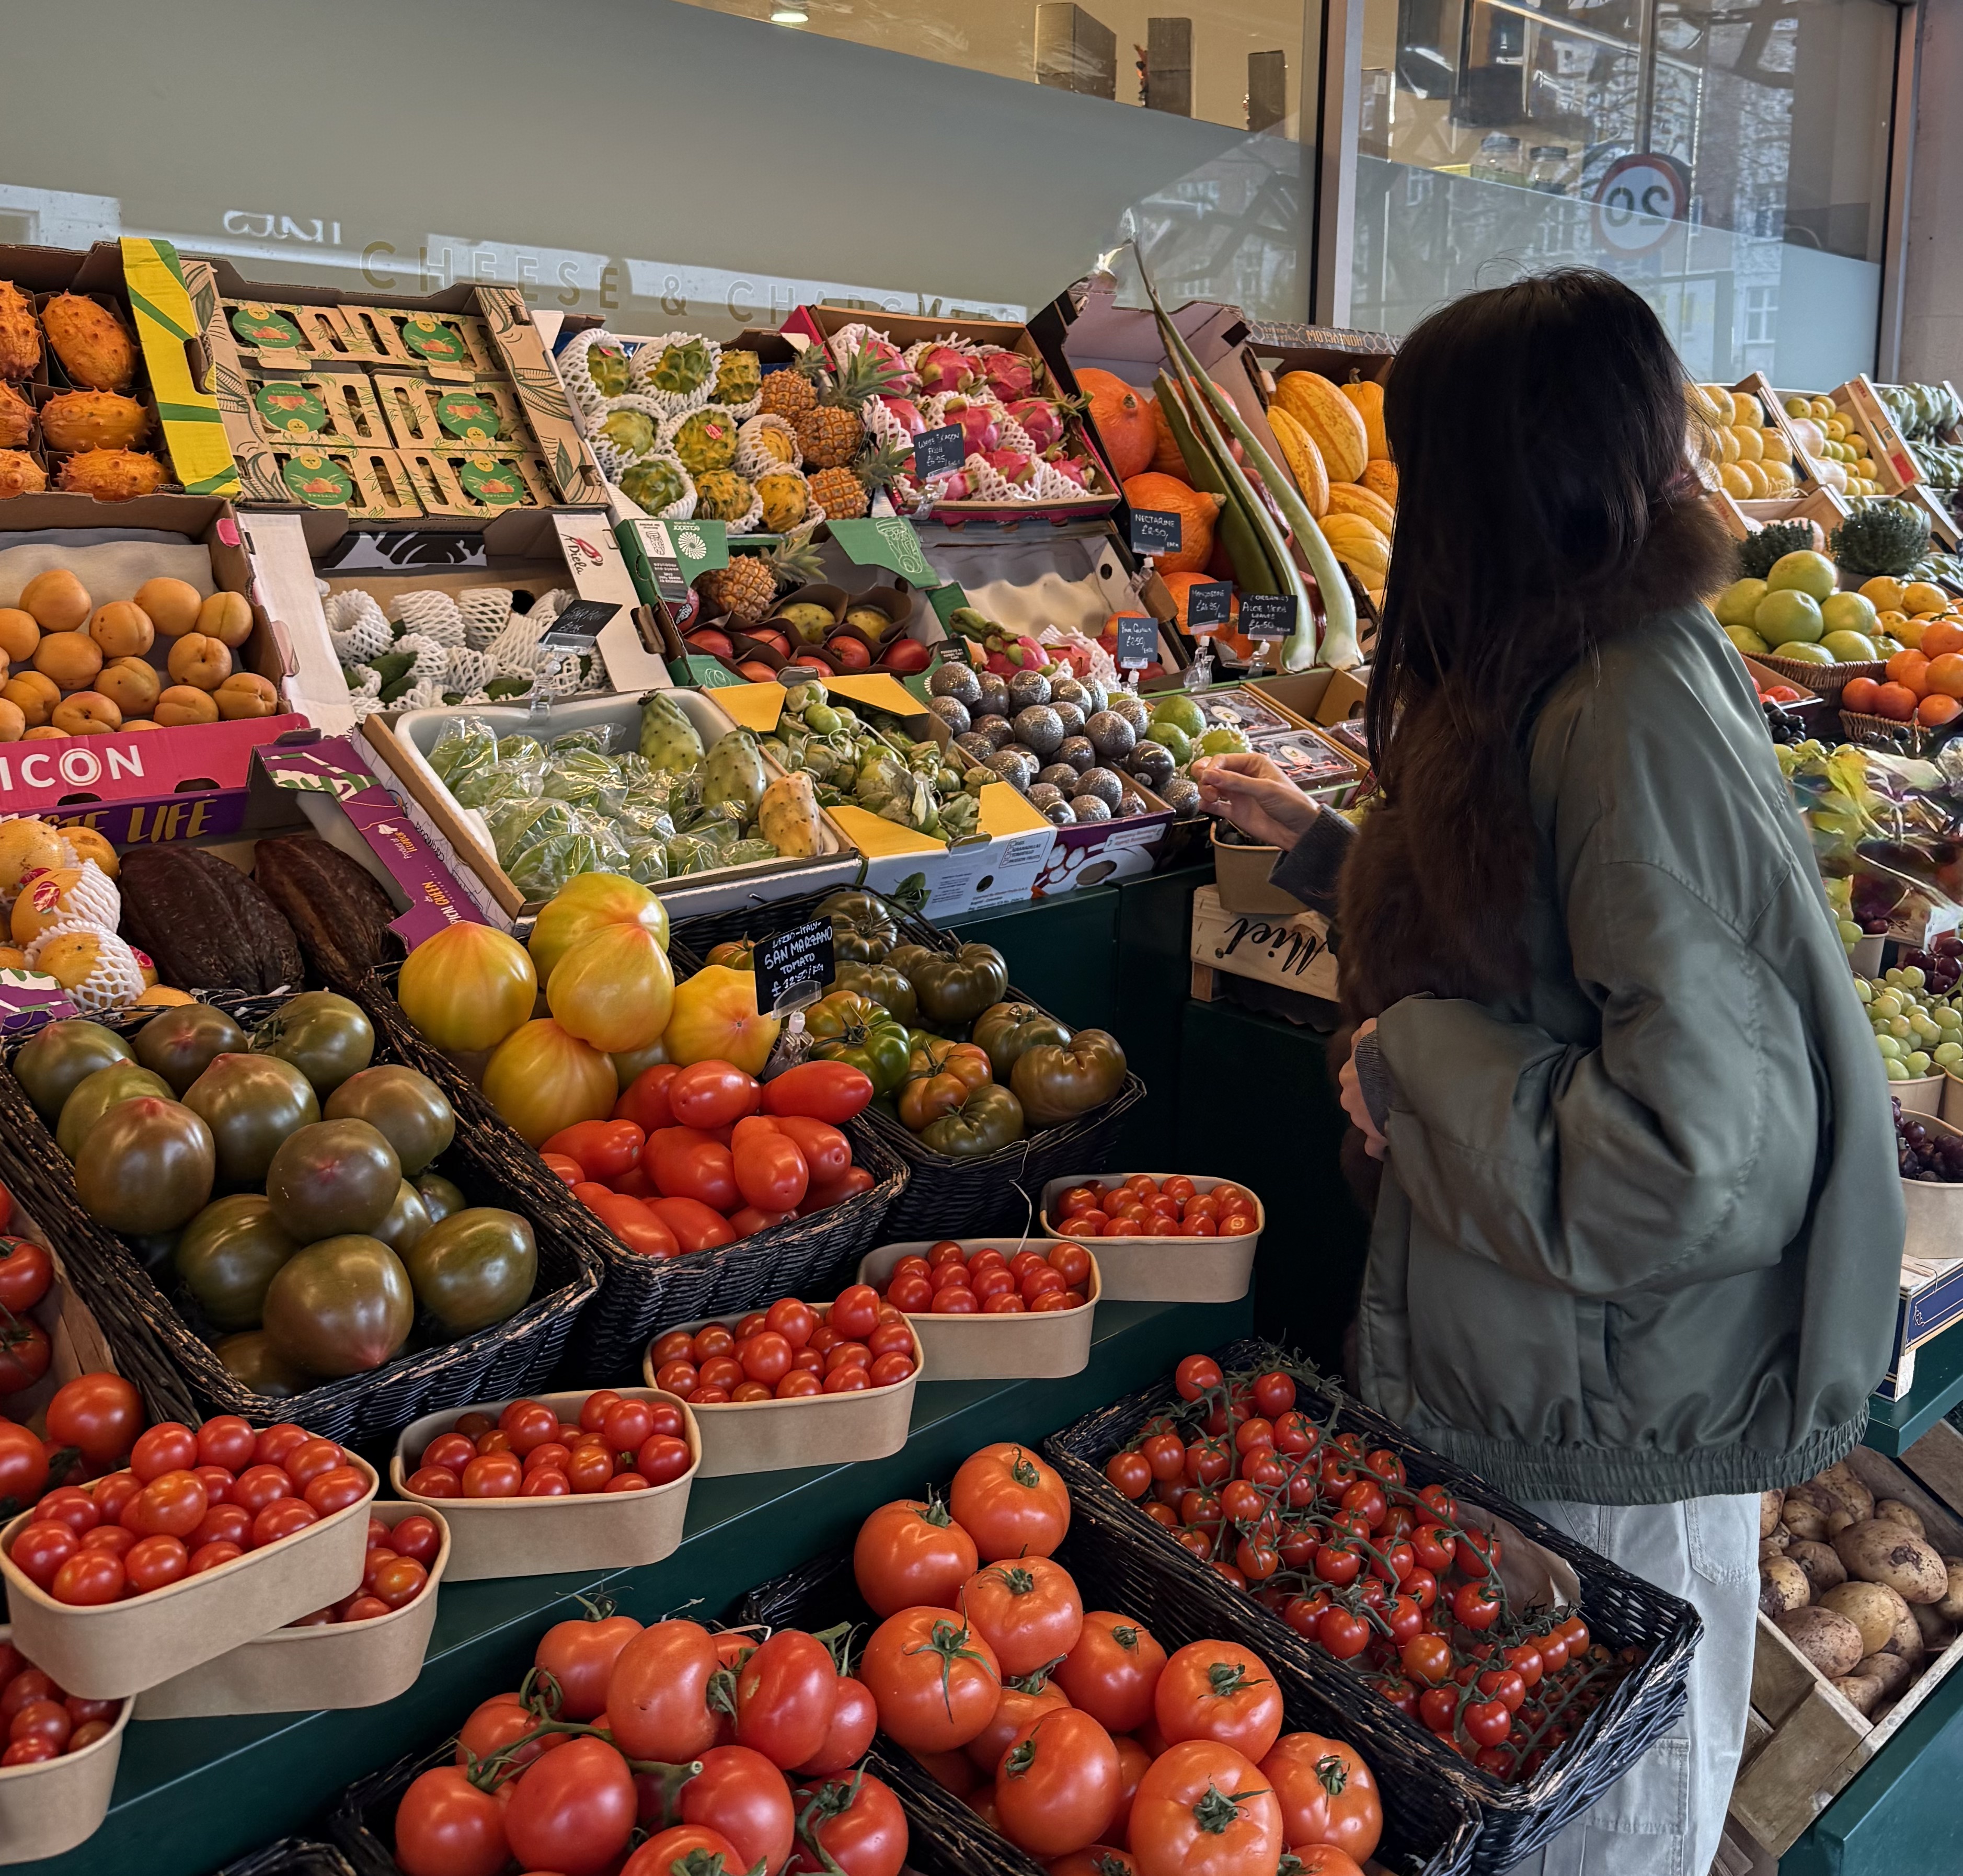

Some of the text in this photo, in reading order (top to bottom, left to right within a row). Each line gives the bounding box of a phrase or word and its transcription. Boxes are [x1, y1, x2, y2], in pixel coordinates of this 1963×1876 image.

[361, 241, 619, 310] CHEESE
[660, 276, 688, 316] &
[1243, 602, 1262, 612] ALOE
[127, 799, 217, 843] LIFE
[422, 882, 450, 905] QUEEN
[764, 926, 833, 970] SAN MARZANO
[780, 953, 815, 974] TOMATO
[1224, 918, 1327, 976] Miel
